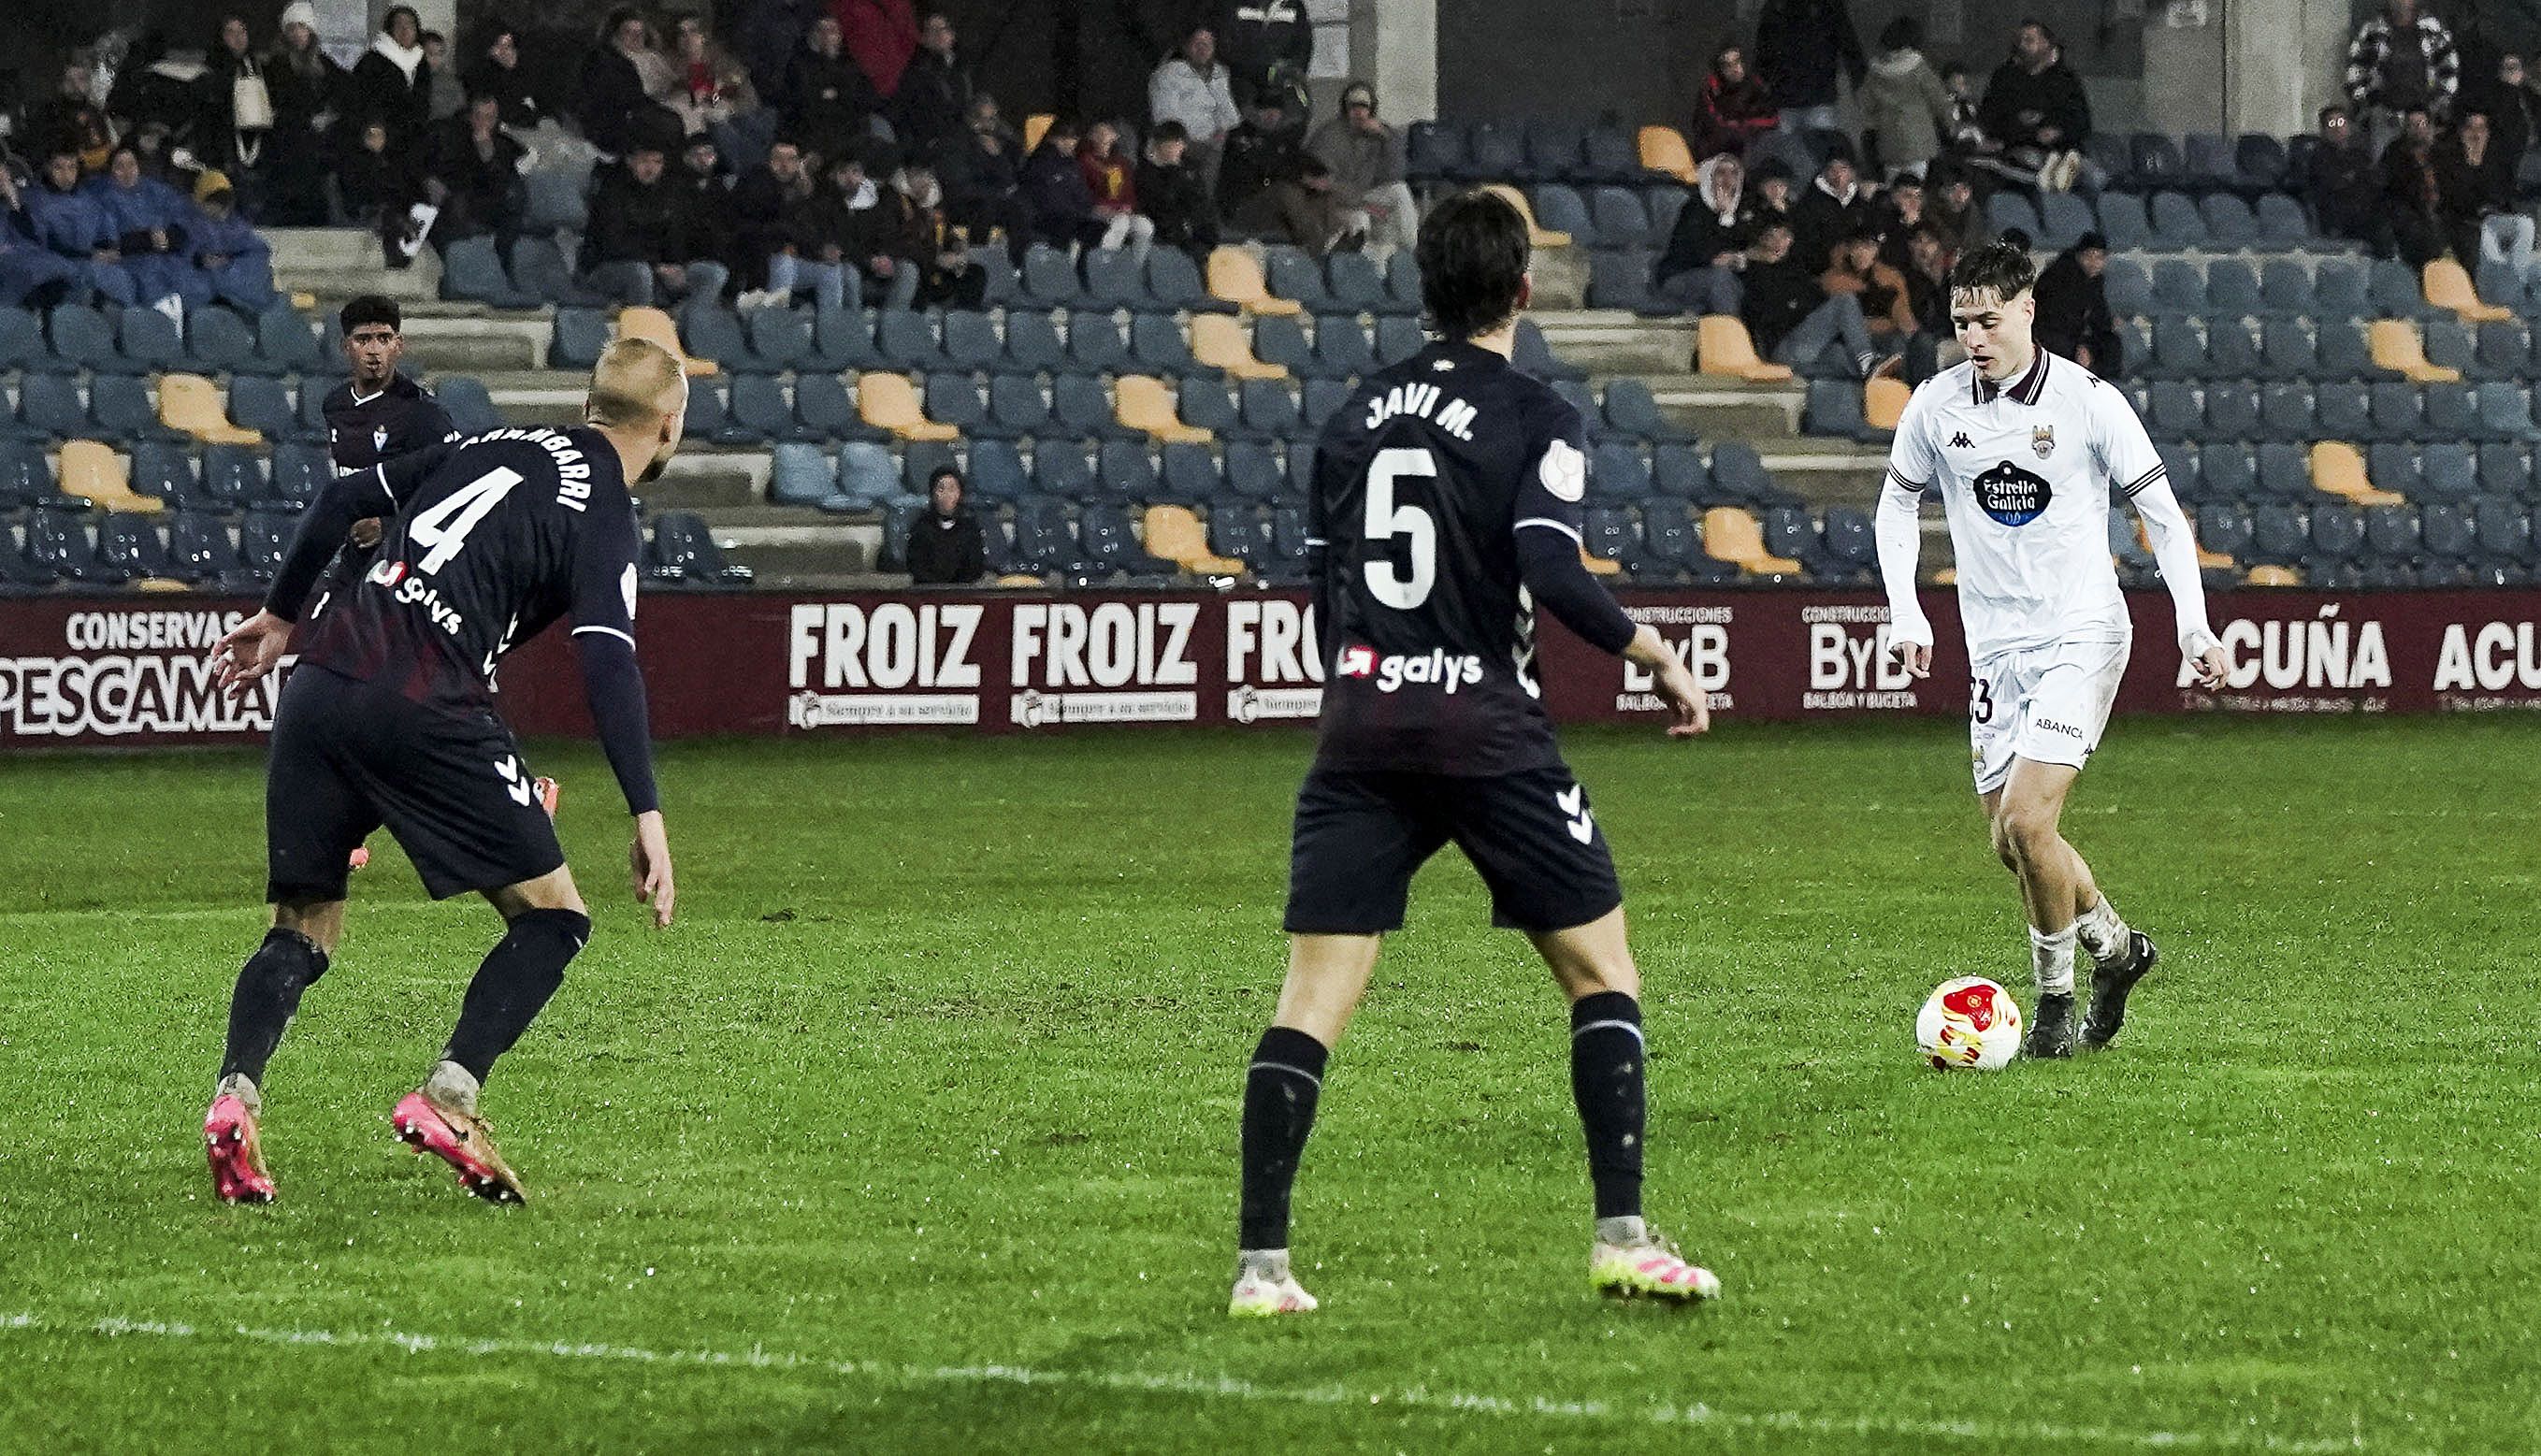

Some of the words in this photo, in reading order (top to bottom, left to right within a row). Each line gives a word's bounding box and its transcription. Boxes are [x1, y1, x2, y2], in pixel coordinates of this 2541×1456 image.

[1365, 382, 1442, 429] JAVI
[1436, 398, 1479, 441] M.
[1984, 478, 2039, 496] Estrella
[1987, 494, 2036, 512] Galicia
[409, 466, 525, 576] 4
[1364, 448, 1437, 610] 5
[65, 610, 245, 650] CONSERVAS
[1621, 606, 1734, 624] ONSTRUCCIONES
[1801, 605, 1890, 624] CONSTRUCCIO
[789, 603, 985, 688] FROIZ
[1011, 602, 1201, 687] FROIZ
[1376, 646, 1483, 695] galys
[0, 655, 298, 737] PESCAMA
[2035, 718, 2084, 741] ABANCA
